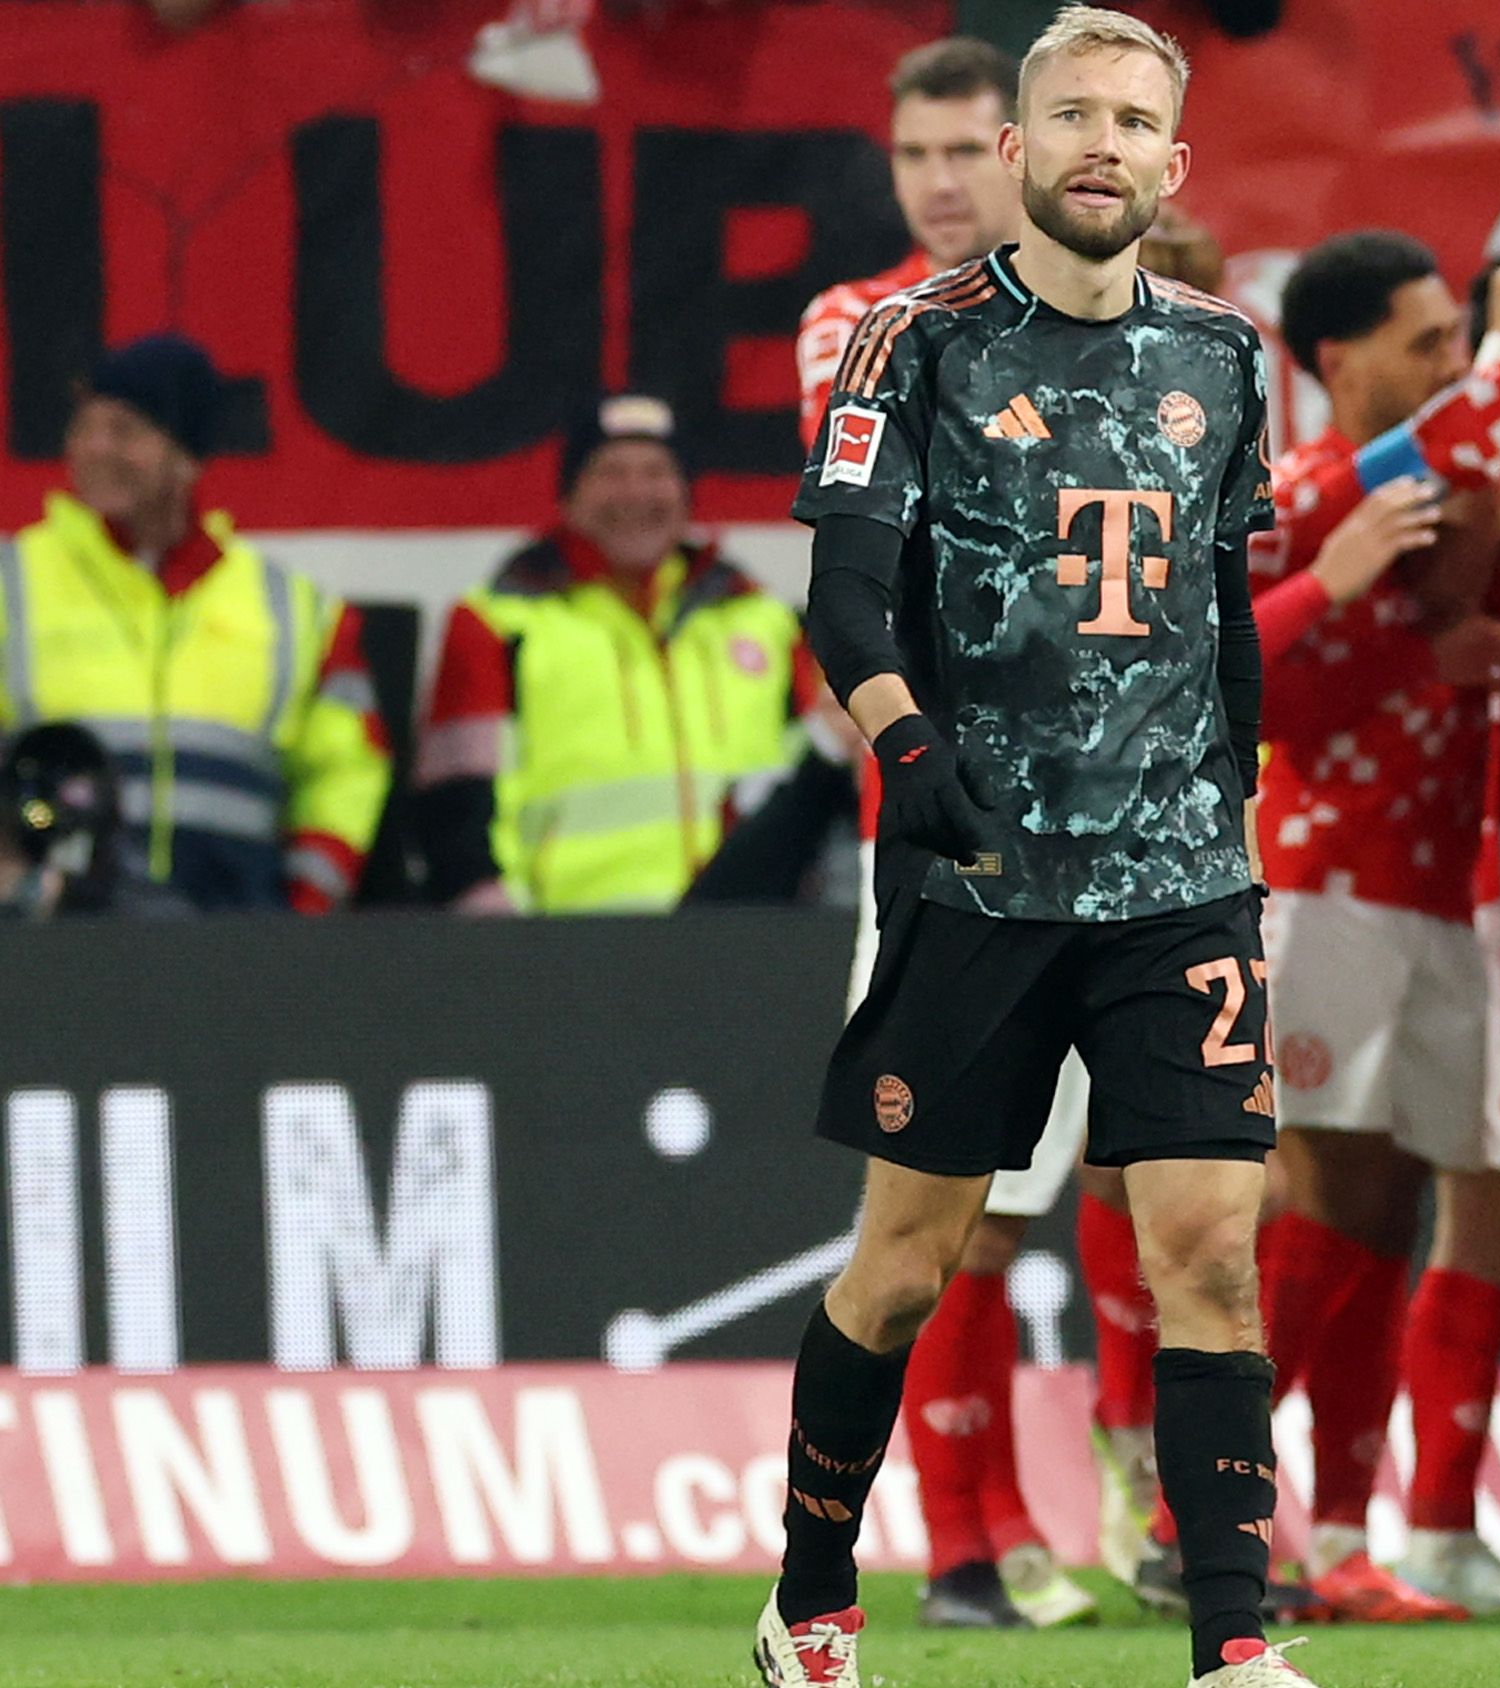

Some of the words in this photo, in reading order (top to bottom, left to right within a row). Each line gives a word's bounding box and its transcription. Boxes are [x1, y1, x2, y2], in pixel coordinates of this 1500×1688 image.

[1056, 489, 1173, 636] T
[0, 1386, 932, 1564] INUM.c
[1216, 1458, 1250, 1474] FC
